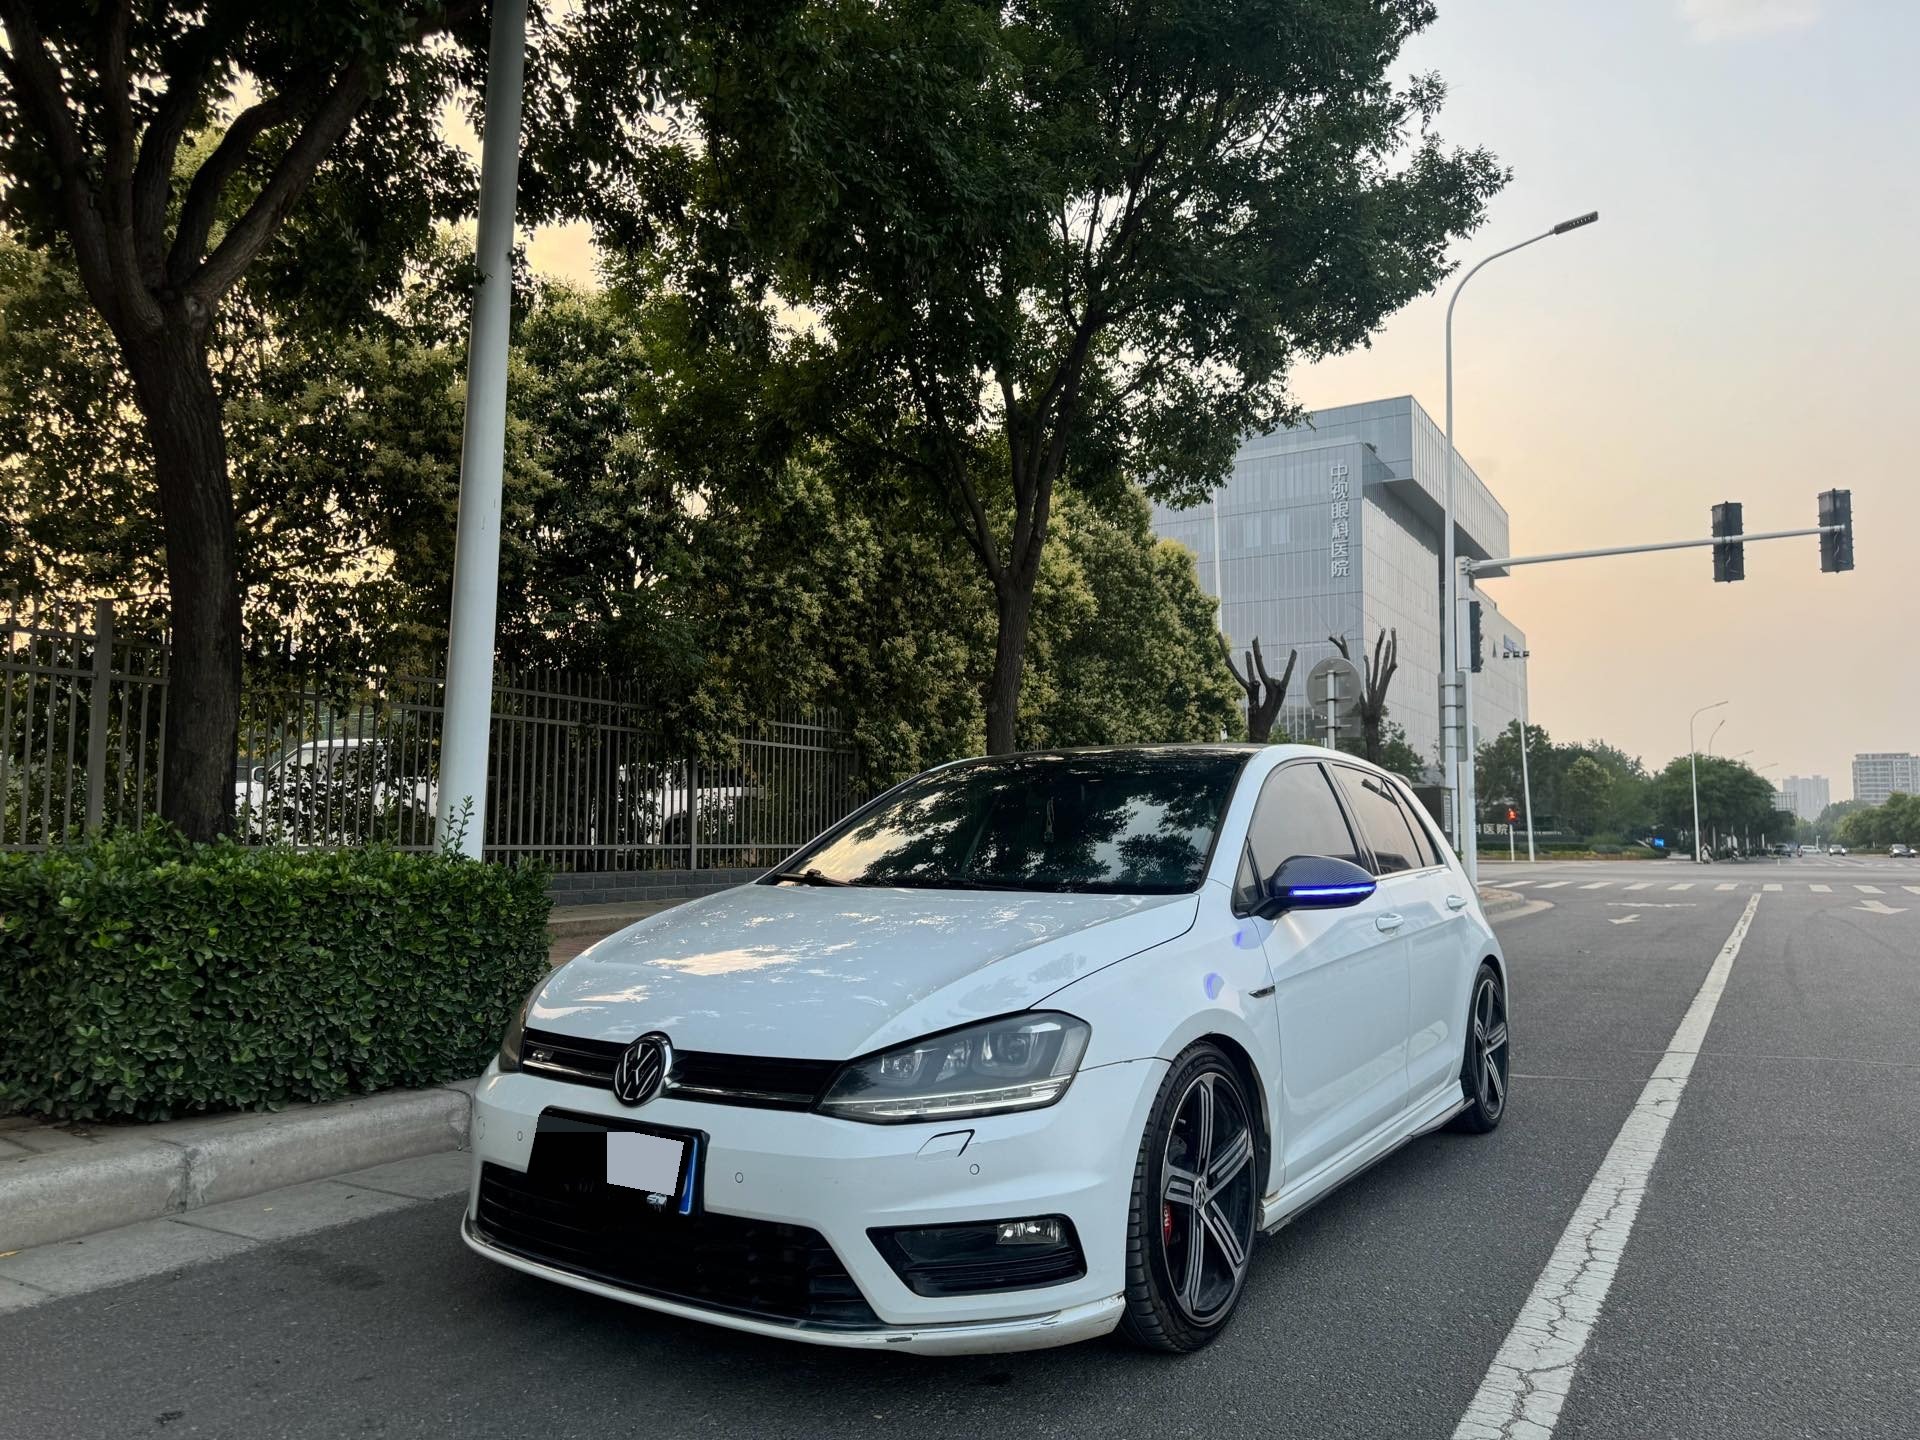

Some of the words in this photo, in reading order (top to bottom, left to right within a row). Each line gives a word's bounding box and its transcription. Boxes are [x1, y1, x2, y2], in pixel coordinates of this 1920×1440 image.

[1331, 464, 1350, 578] 中视眼科医院
